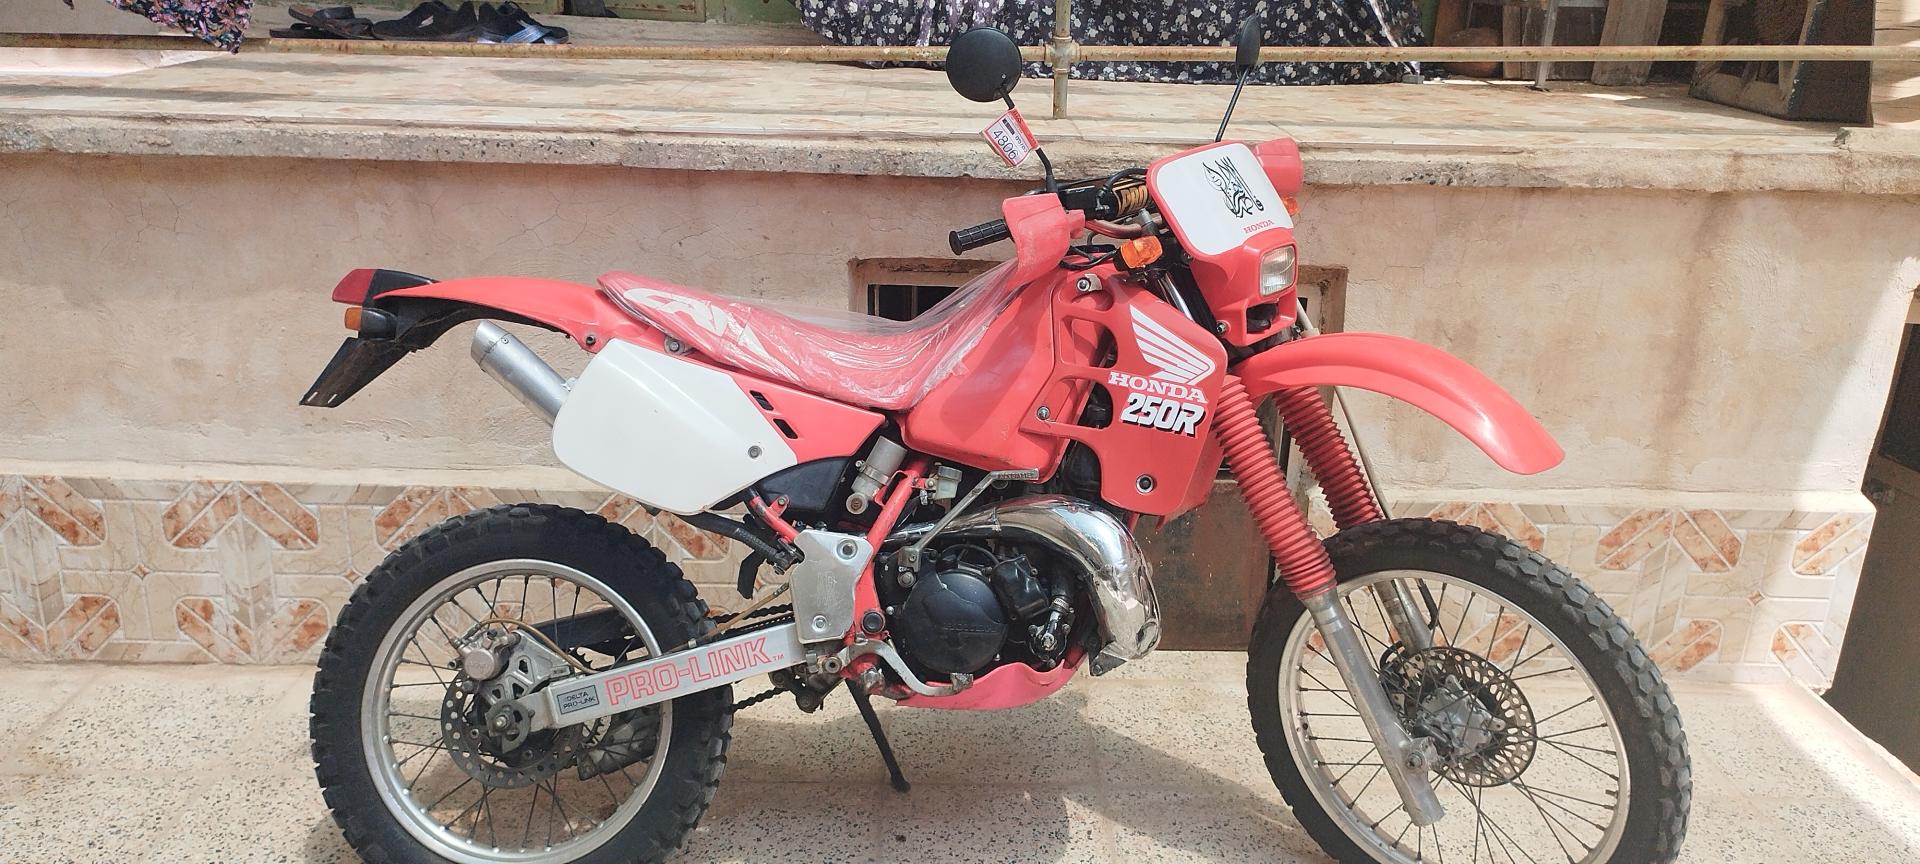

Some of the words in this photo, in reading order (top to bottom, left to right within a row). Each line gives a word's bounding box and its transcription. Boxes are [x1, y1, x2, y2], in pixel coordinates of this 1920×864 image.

[993, 130, 1018, 160] 4806
[1243, 219, 1274, 234] HONDA
[1108, 371, 1208, 404] HONDA
[1121, 392, 1206, 437] 250R
[605, 636, 771, 706] PRO-LINK
[562, 695, 596, 709] PRO-LINK
[566, 691, 589, 702] DELTA
